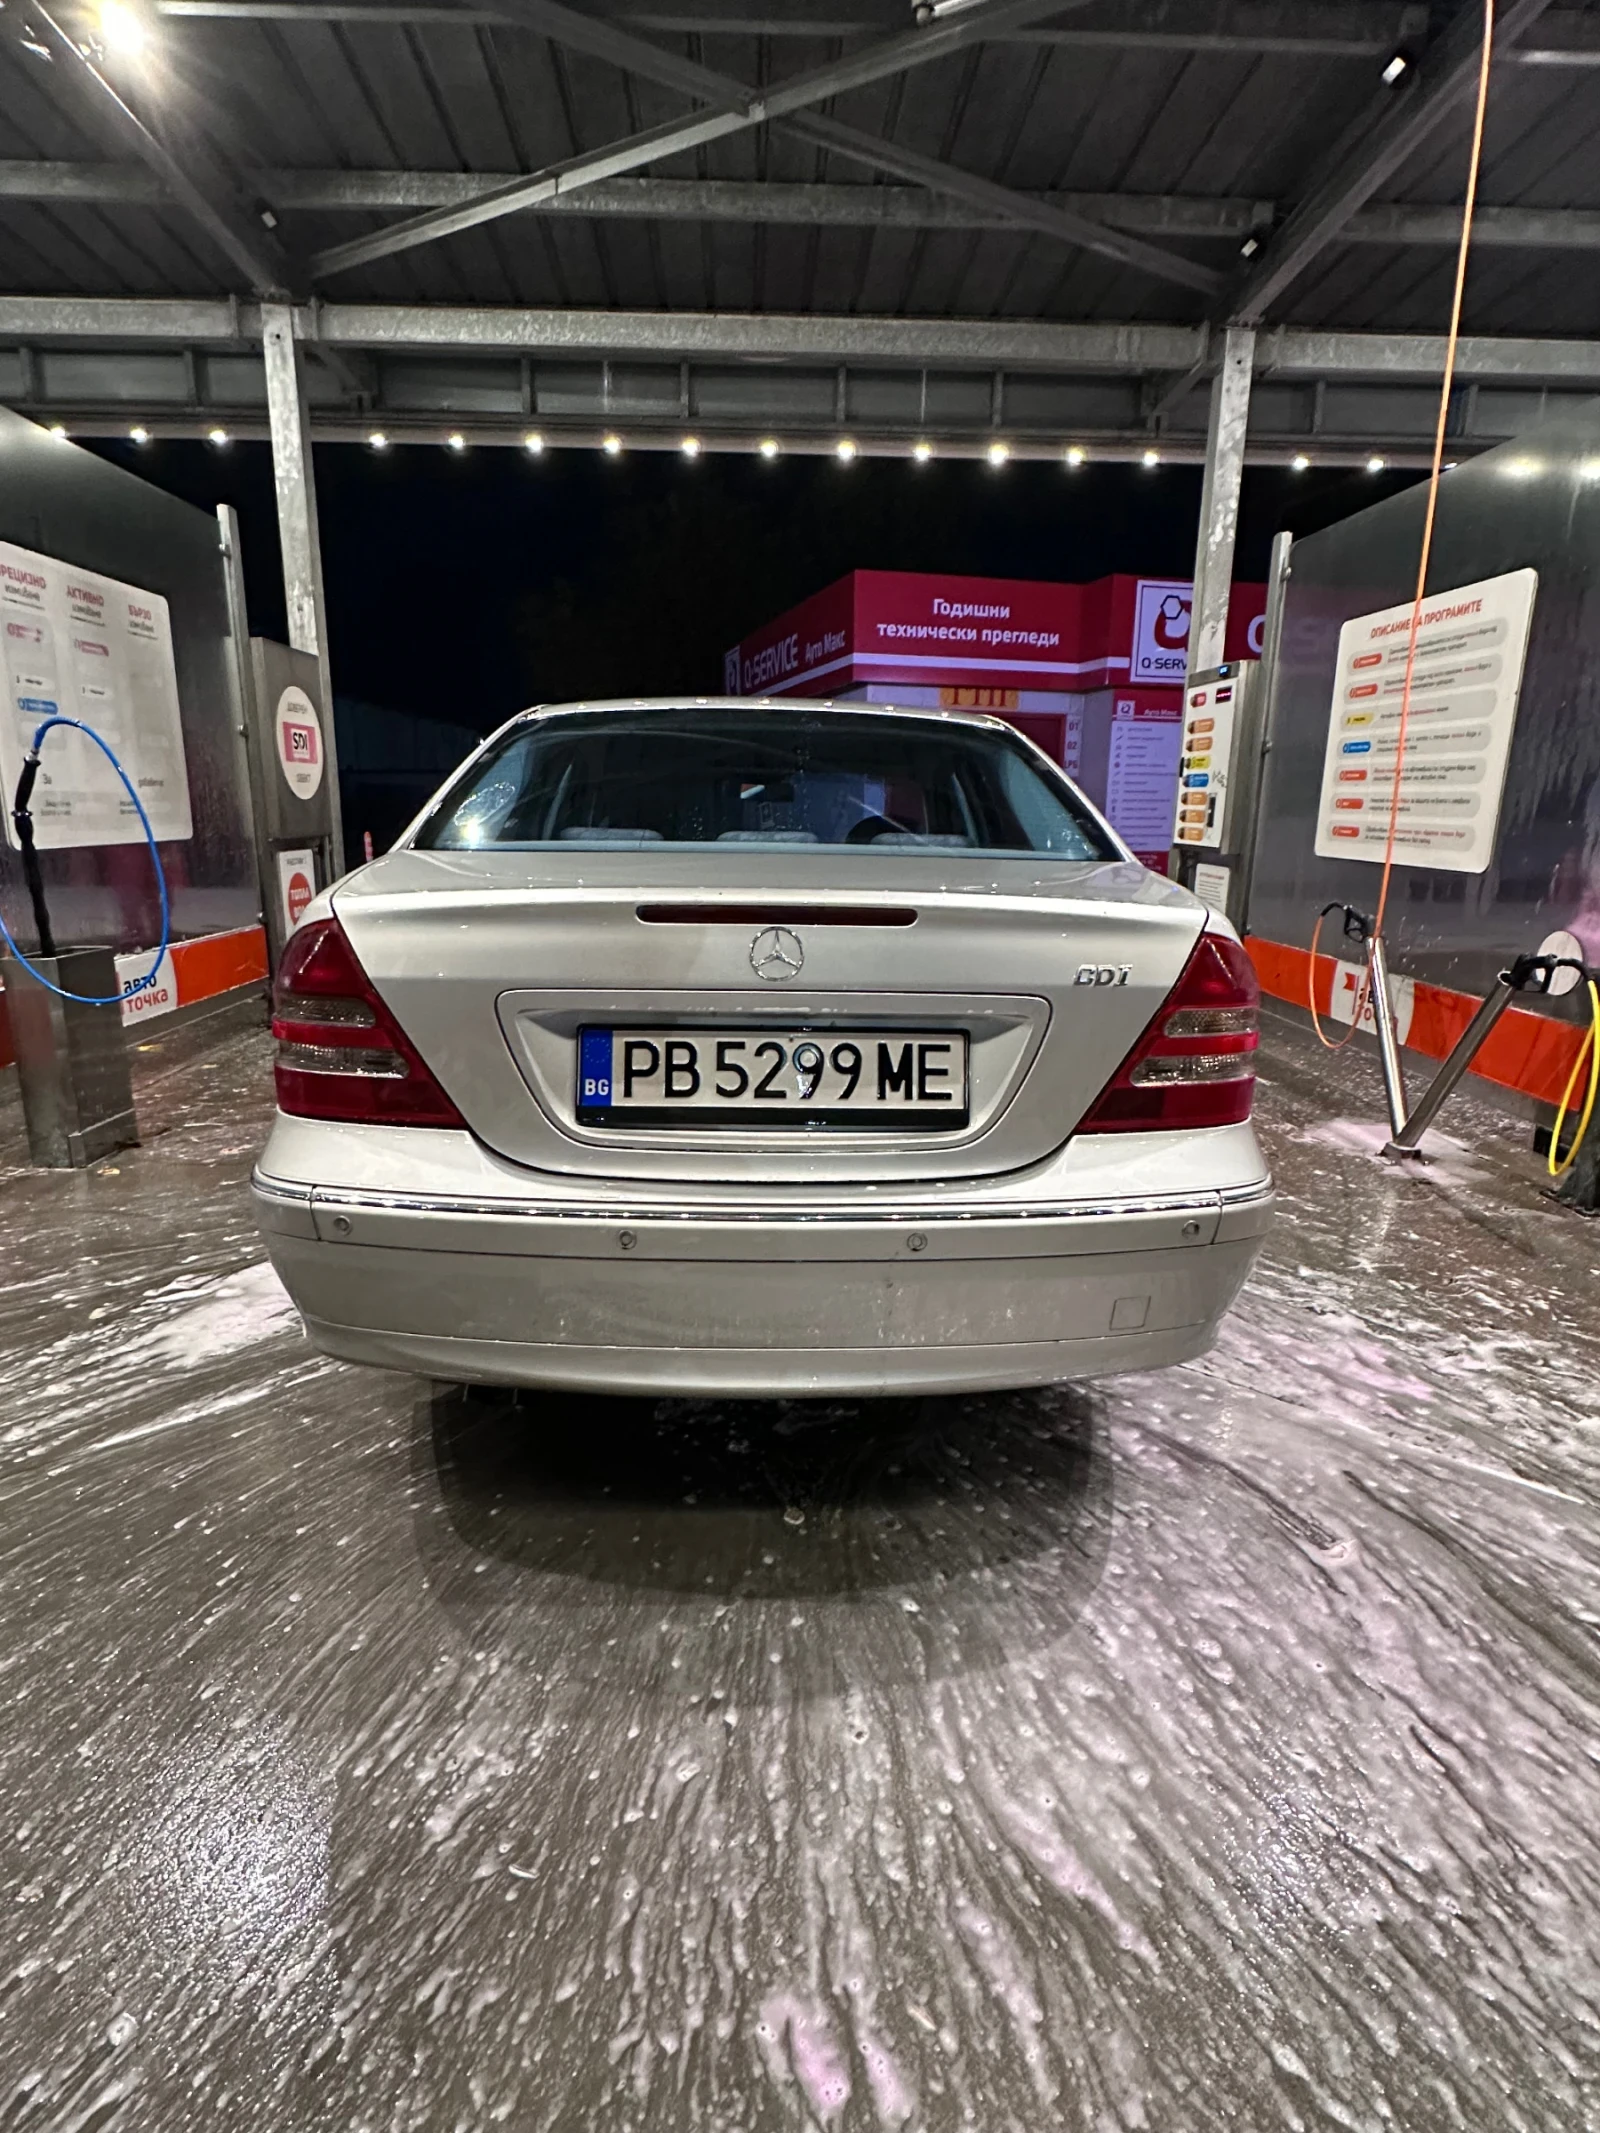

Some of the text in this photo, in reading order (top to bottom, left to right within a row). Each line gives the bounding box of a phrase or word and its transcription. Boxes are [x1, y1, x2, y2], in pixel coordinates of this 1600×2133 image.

[0, 564, 46, 589] РЕЦИЗНО
[66, 585, 104, 607] АКТИВНО
[933, 598, 1010, 619] Годишни
[1370, 618, 1411, 640] ОПИСАНИЕ
[1424, 599, 1483, 625] ПРОГРАМИТЕ
[877, 622, 1060, 648] технически прегледи
[293, 731, 308, 751] SDI
[1073, 964, 1133, 987] CDI
[126, 988, 168, 1013] точка
[623, 1041, 953, 1100] PB 5299 ME
[585, 1079, 609, 1096] BG
